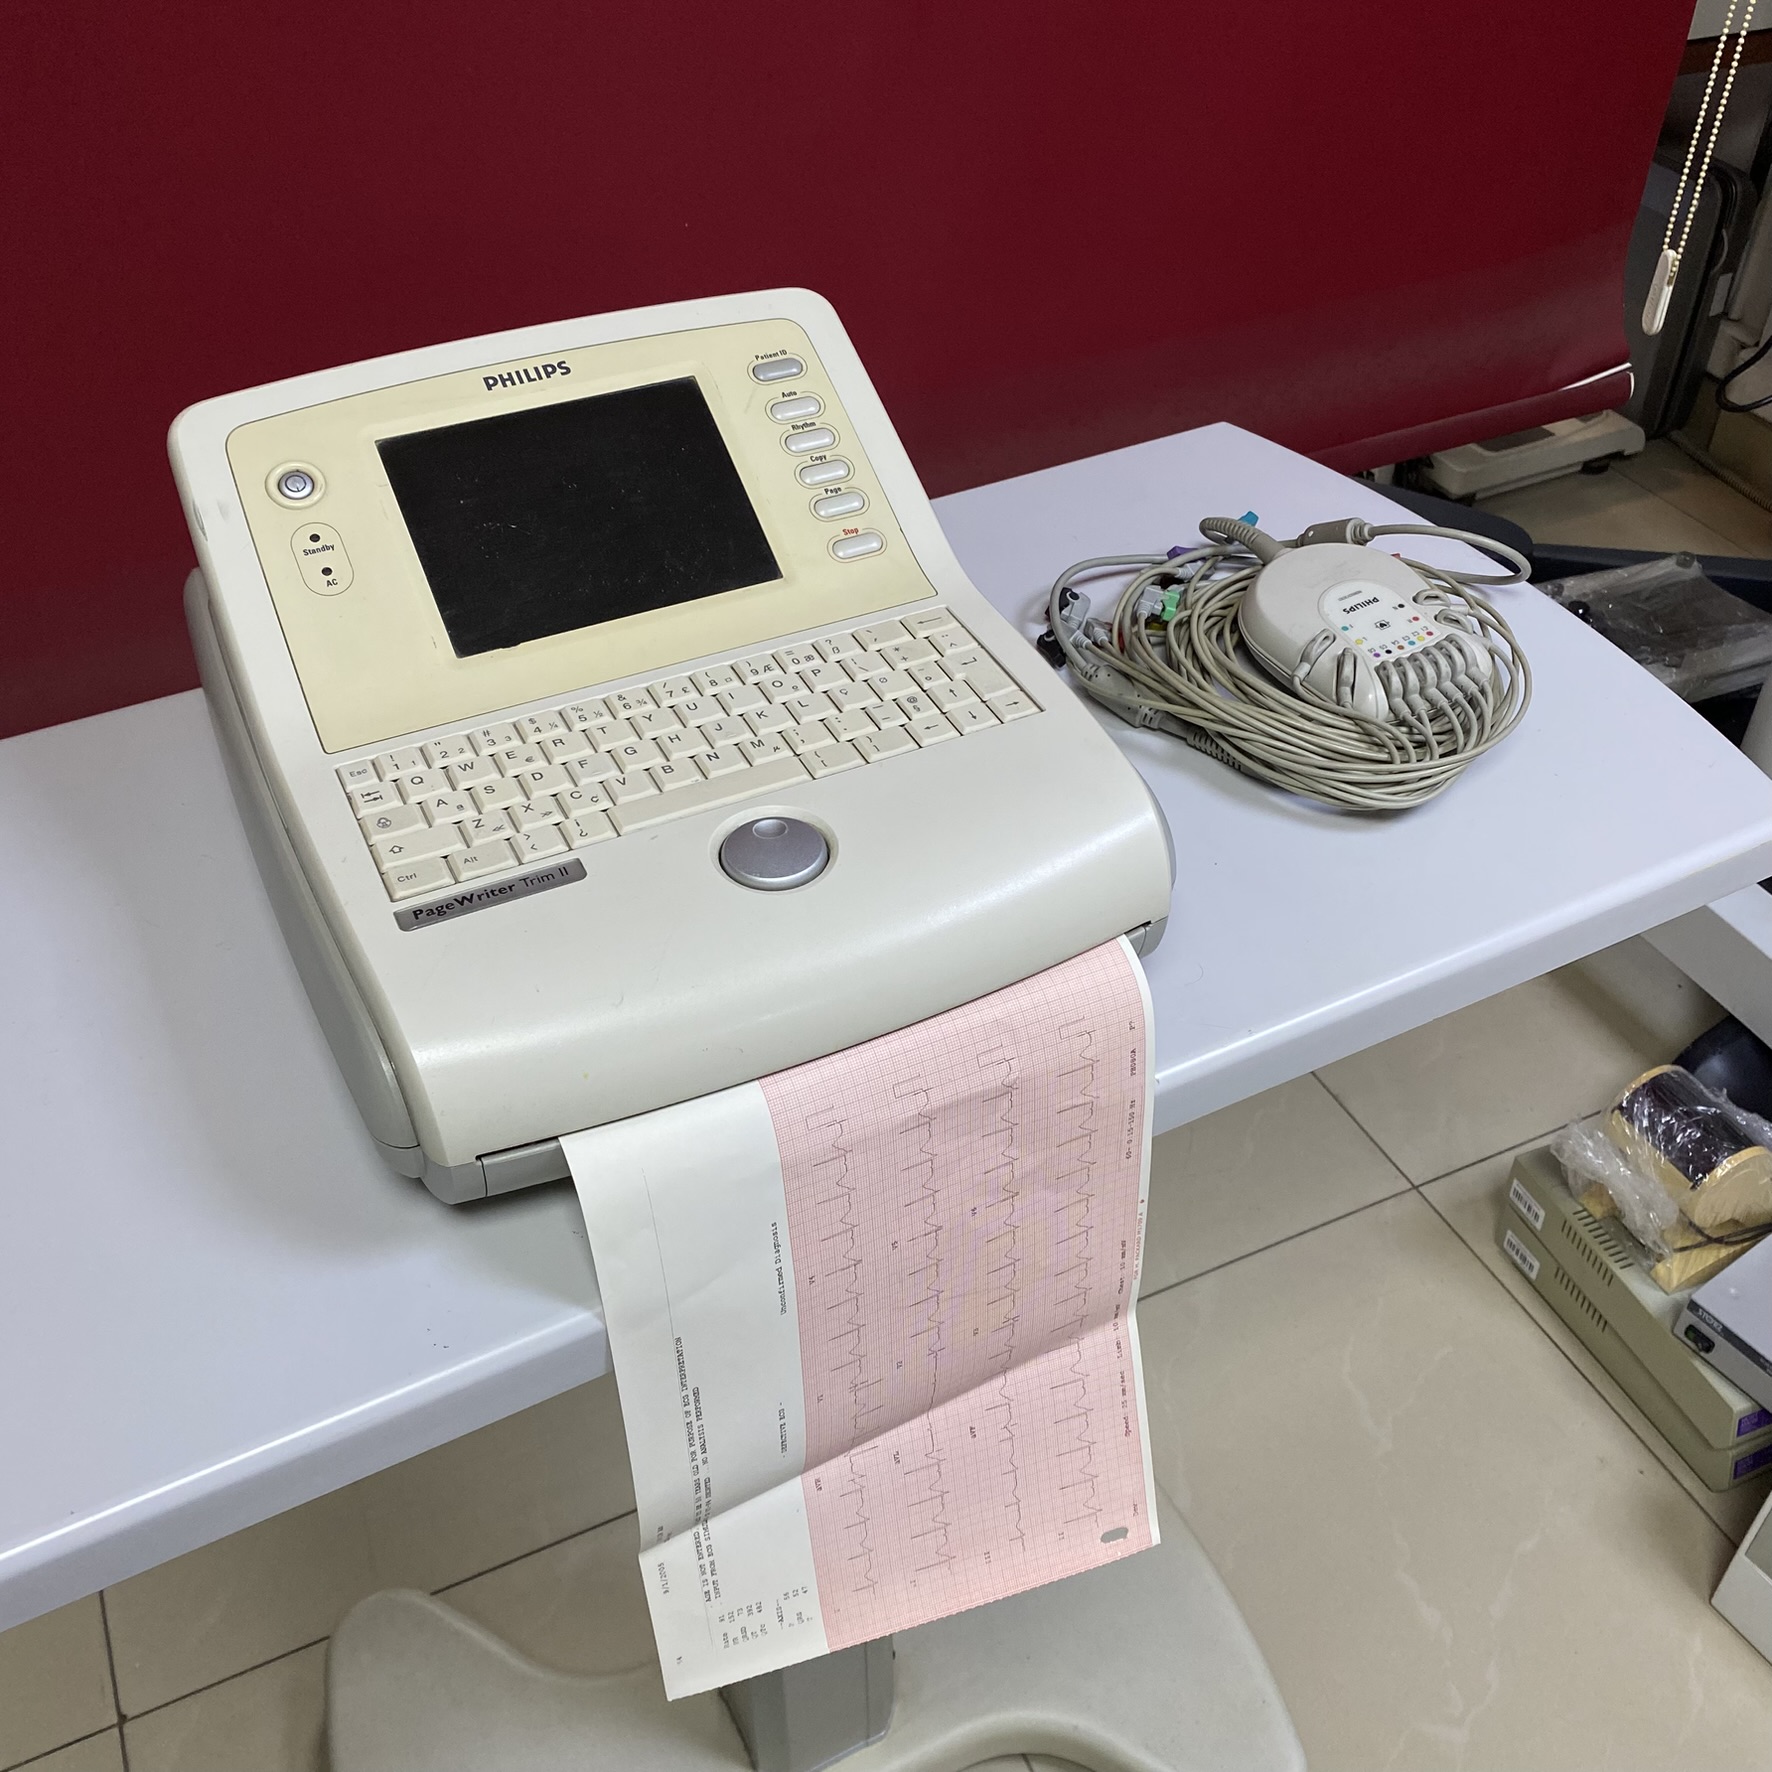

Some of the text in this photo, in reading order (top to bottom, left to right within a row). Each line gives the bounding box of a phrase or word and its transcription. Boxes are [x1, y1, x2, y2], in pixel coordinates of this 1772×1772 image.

[755, 351, 779, 361] Patient
[482, 360, 571, 391] PHILIPS
[781, 390, 797, 399] Auto
[791, 421, 816, 431] Rhythm
[810, 454, 827, 463] Copy
[824, 486, 842, 496] Page
[842, 527, 859, 536] Stop
[302, 543, 335, 557] Standby
[326, 578, 338, 587] AC
[1343, 596, 1380, 615] PHILIPS
[811, 668, 821, 677] P
[686, 702, 698, 712] U
[797, 700, 809, 709] L
[642, 713, 653, 722] Y
[755, 710, 769, 720] K
[597, 726, 608, 735] T
[714, 722, 723, 732] J
[552, 738, 566, 747] R
[668, 733, 682, 744] H
[750, 739, 765, 749] M
[505, 750, 518, 760] E
[624, 746, 638, 756] G
[706, 752, 720, 762] N
[457, 761, 475, 773] W
[578, 759, 589, 769] F
[661, 764, 675, 774] B
[349, 767, 368, 778] Esc
[531, 772, 544, 782] D
[410, 776, 425, 786] Q
[615, 777, 627, 786] V
[483, 785, 496, 795] S
[570, 790, 582, 800] C
[436, 798, 449, 808] A
[521, 803, 535, 814] X
[472, 818, 485, 829] Z
[463, 855, 479, 865] Alt
[397, 872, 417, 883] Ctrl
[412, 882, 516, 922] PageWriter
[519, 873, 556, 888] Trim
[770, 1221, 782, 1265] Diagnosis
[674, 1336, 688, 1392] INTERPRETATION
[697, 1424, 708, 1455] ANALYSIS
